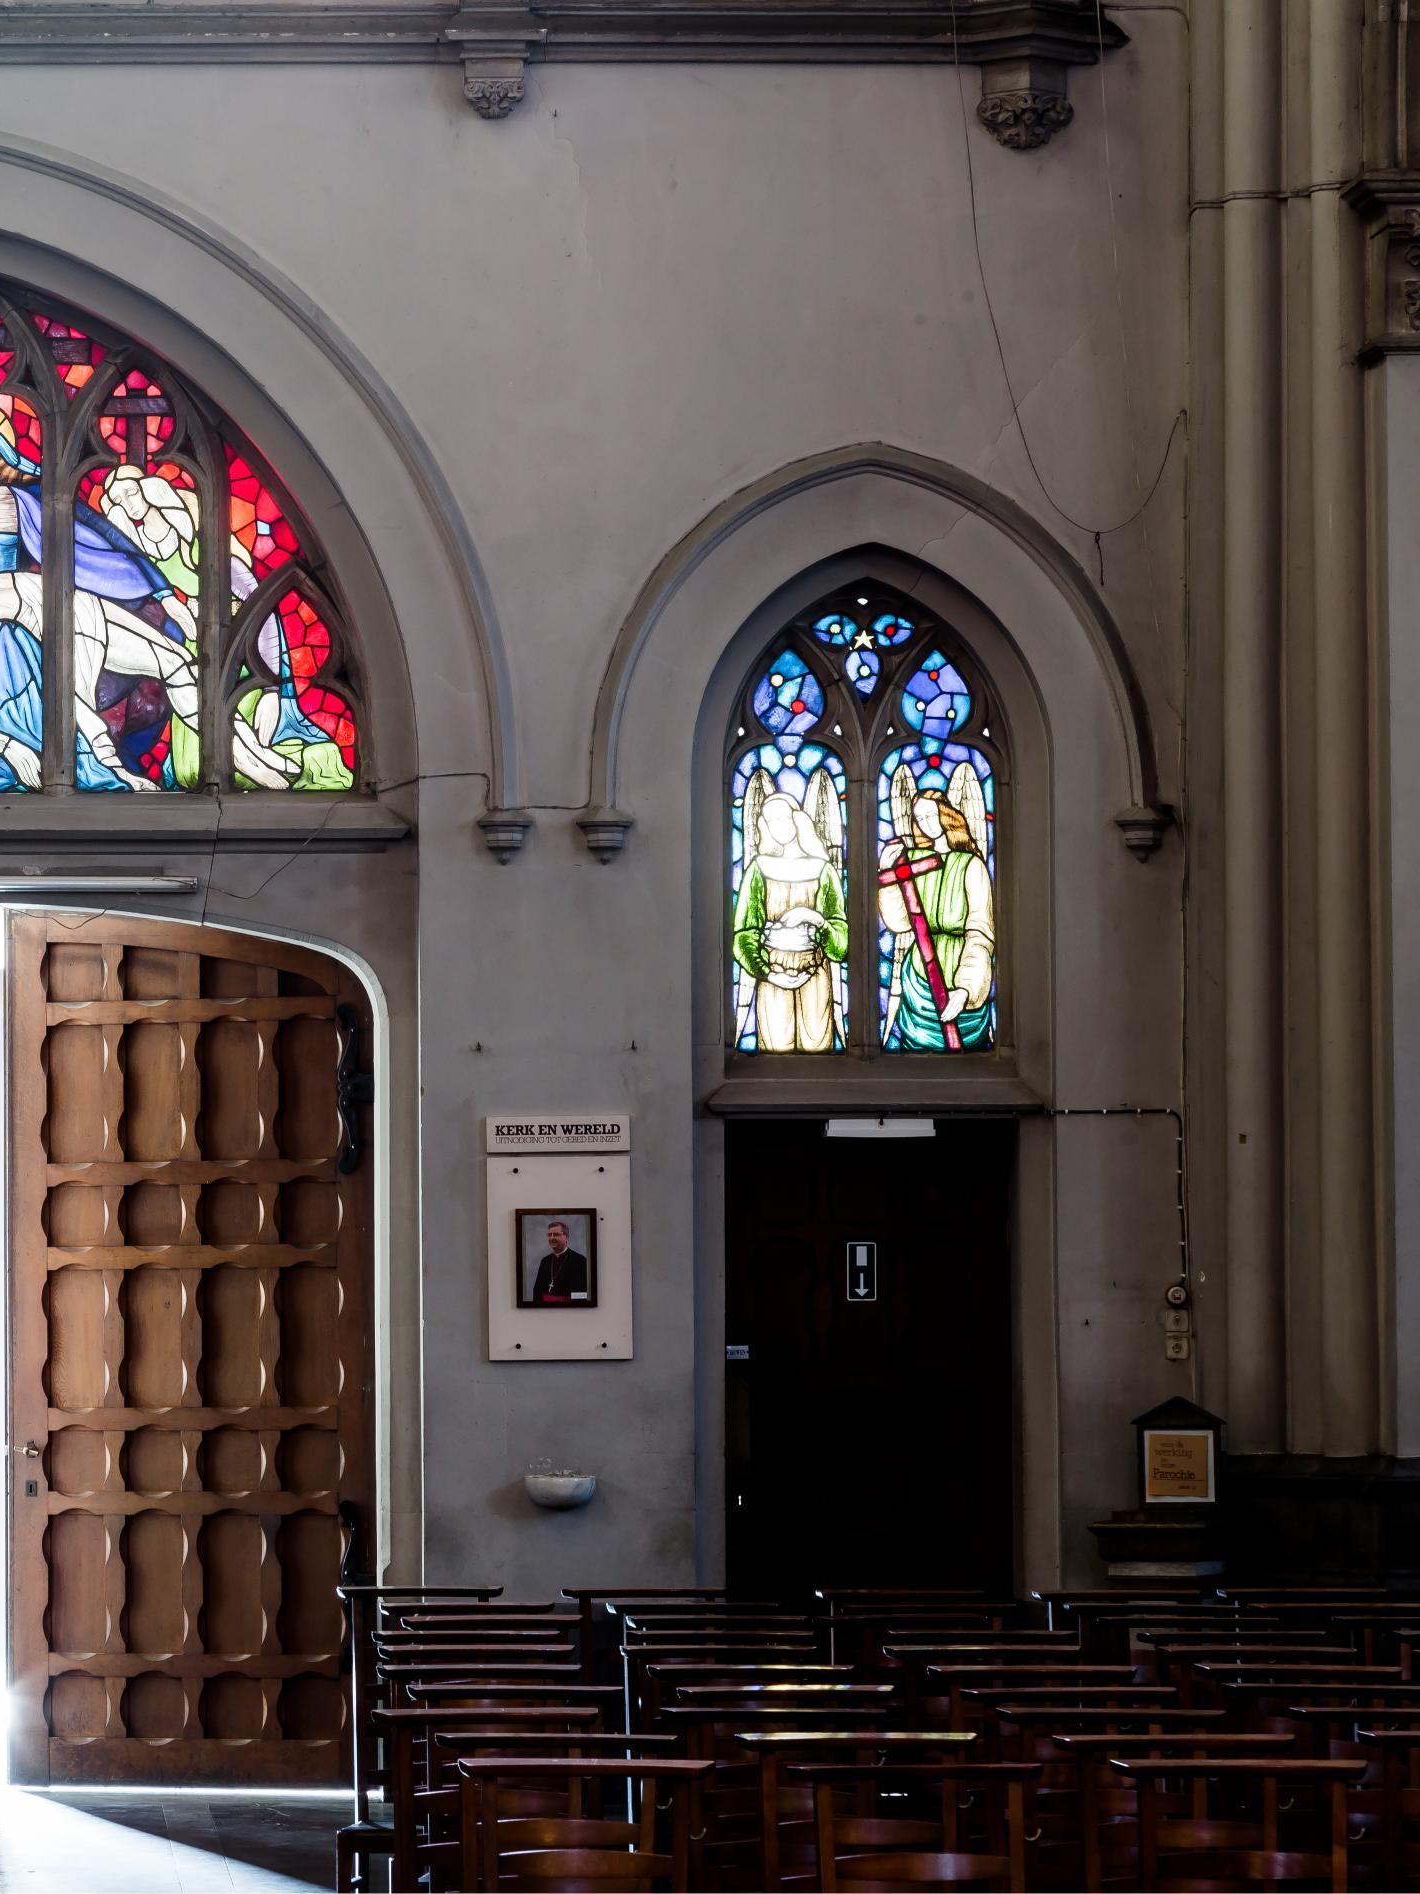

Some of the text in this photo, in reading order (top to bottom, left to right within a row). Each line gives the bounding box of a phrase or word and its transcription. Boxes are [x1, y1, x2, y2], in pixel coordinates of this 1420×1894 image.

[495, 1124, 621, 1136] KERK EN WERELD
[1153, 1467, 1196, 1480] Parochie
